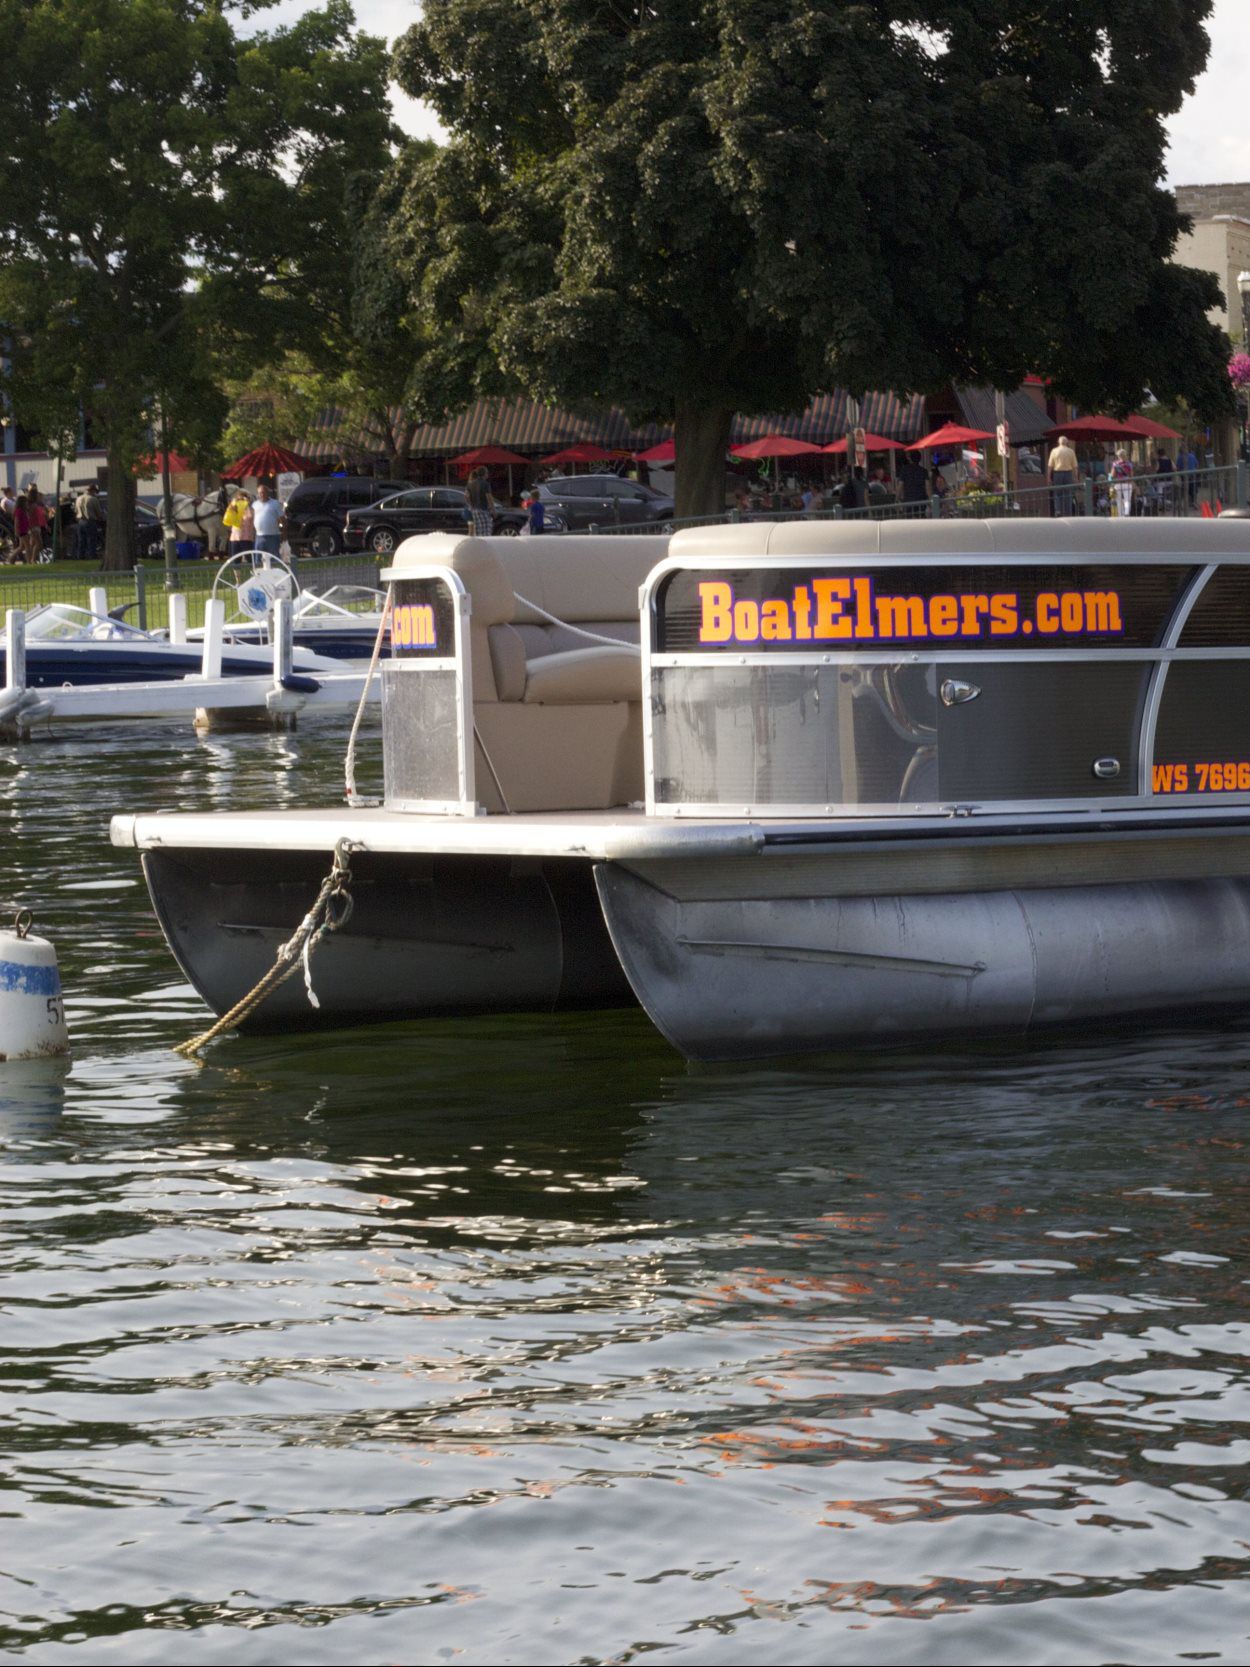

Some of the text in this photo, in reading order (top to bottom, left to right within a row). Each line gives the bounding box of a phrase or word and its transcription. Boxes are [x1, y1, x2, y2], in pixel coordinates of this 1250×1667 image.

[698, 577, 1122, 643] BoatElmers.com
[1152, 764, 1188, 793] WS
[1195, 762, 1250, 791] 7696
